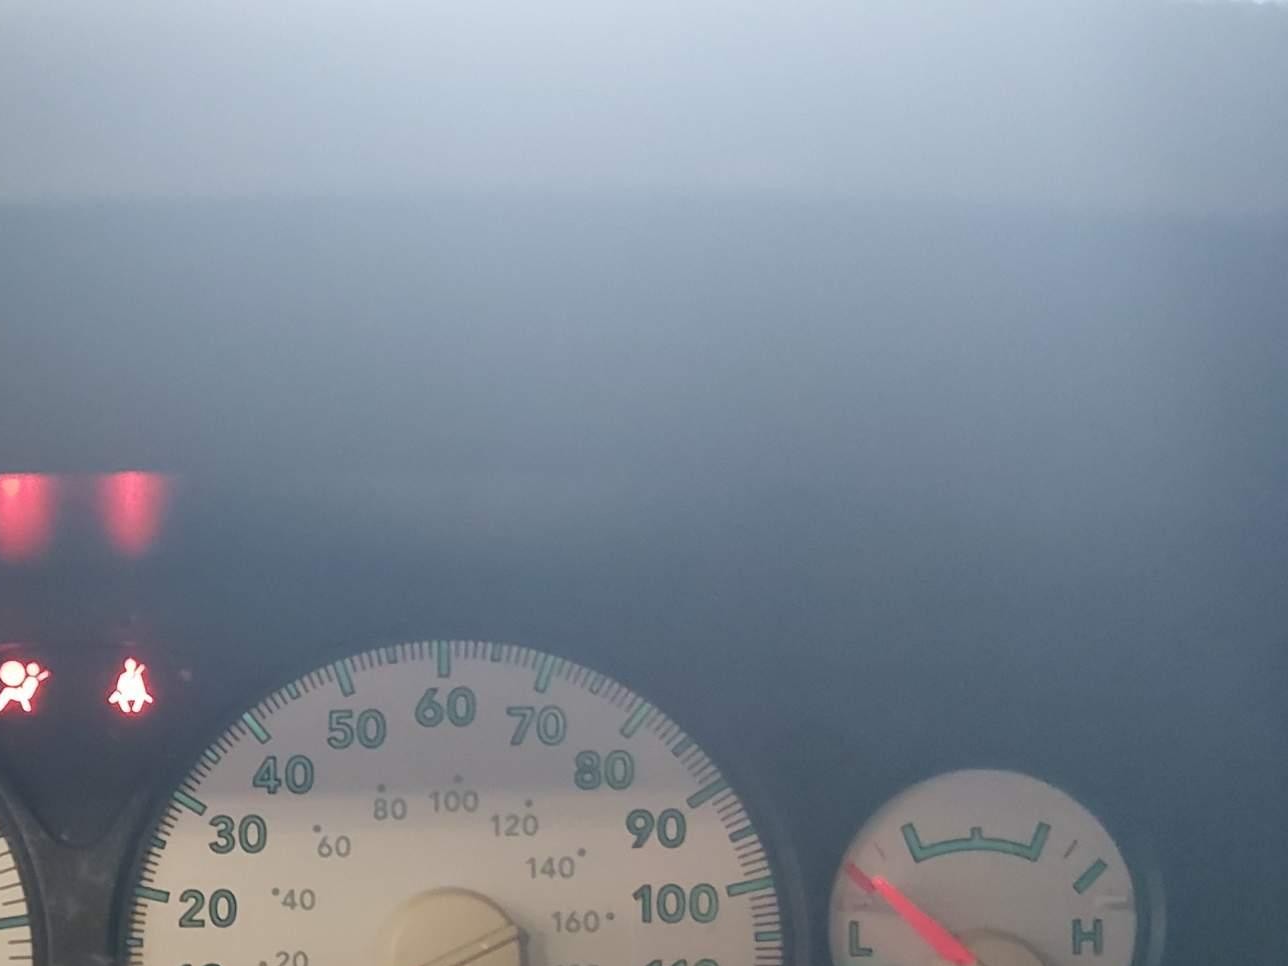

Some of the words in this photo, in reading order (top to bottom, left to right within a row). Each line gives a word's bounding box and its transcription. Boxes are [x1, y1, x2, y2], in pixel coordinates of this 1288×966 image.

[415, 688, 476, 727] 60
[507, 706, 566, 745] 70
[327, 710, 386, 749] 50
[253, 756, 314, 794] 40
[574, 751, 634, 789] 80
[373, 798, 407, 820] 80
[429, 791, 479, 812] 100
[208, 815, 267, 853] 30
[491, 815, 538, 837] 120
[626, 809, 686, 848] 90
[317, 836, 351, 857] 60
[526, 857, 575, 879] 140
[178, 890, 237, 928] 20
[282, 889, 316, 910] 40
[633, 884, 719, 923] 100
[552, 911, 599, 933] 160
[850, 921, 872, 957] L
[1072, 919, 1103, 954] H
